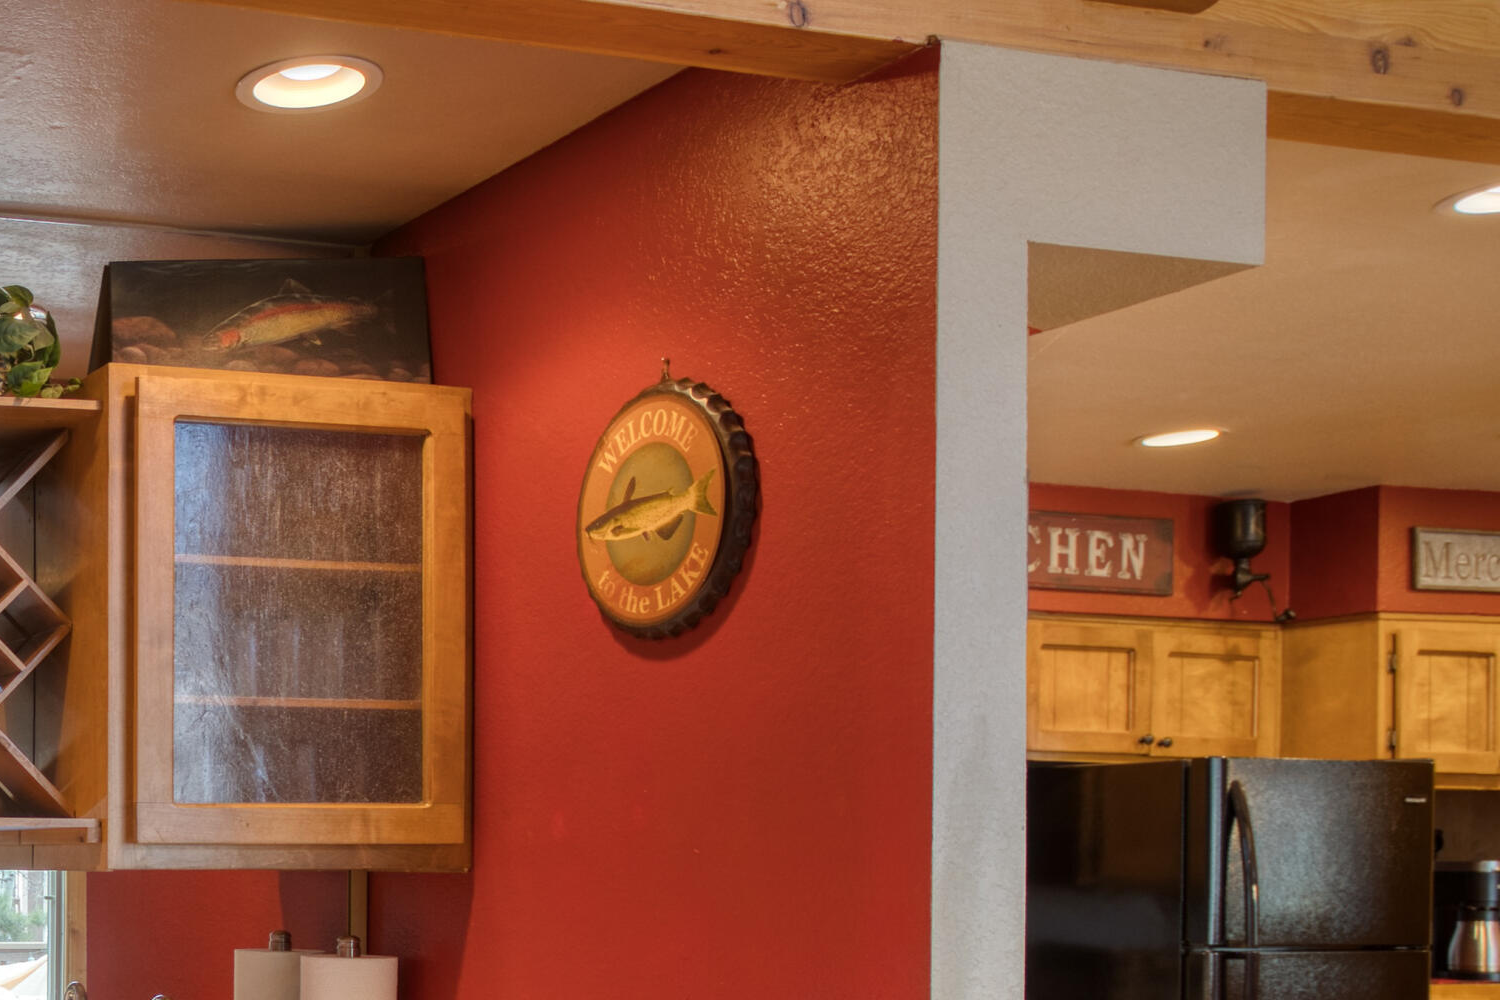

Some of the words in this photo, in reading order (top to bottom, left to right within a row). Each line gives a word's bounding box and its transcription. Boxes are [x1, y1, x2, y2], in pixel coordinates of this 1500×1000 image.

[598, 408, 699, 475] WELCOME
[598, 570, 616, 598] to
[619, 586, 650, 614] the
[654, 542, 709, 611] LAKE
